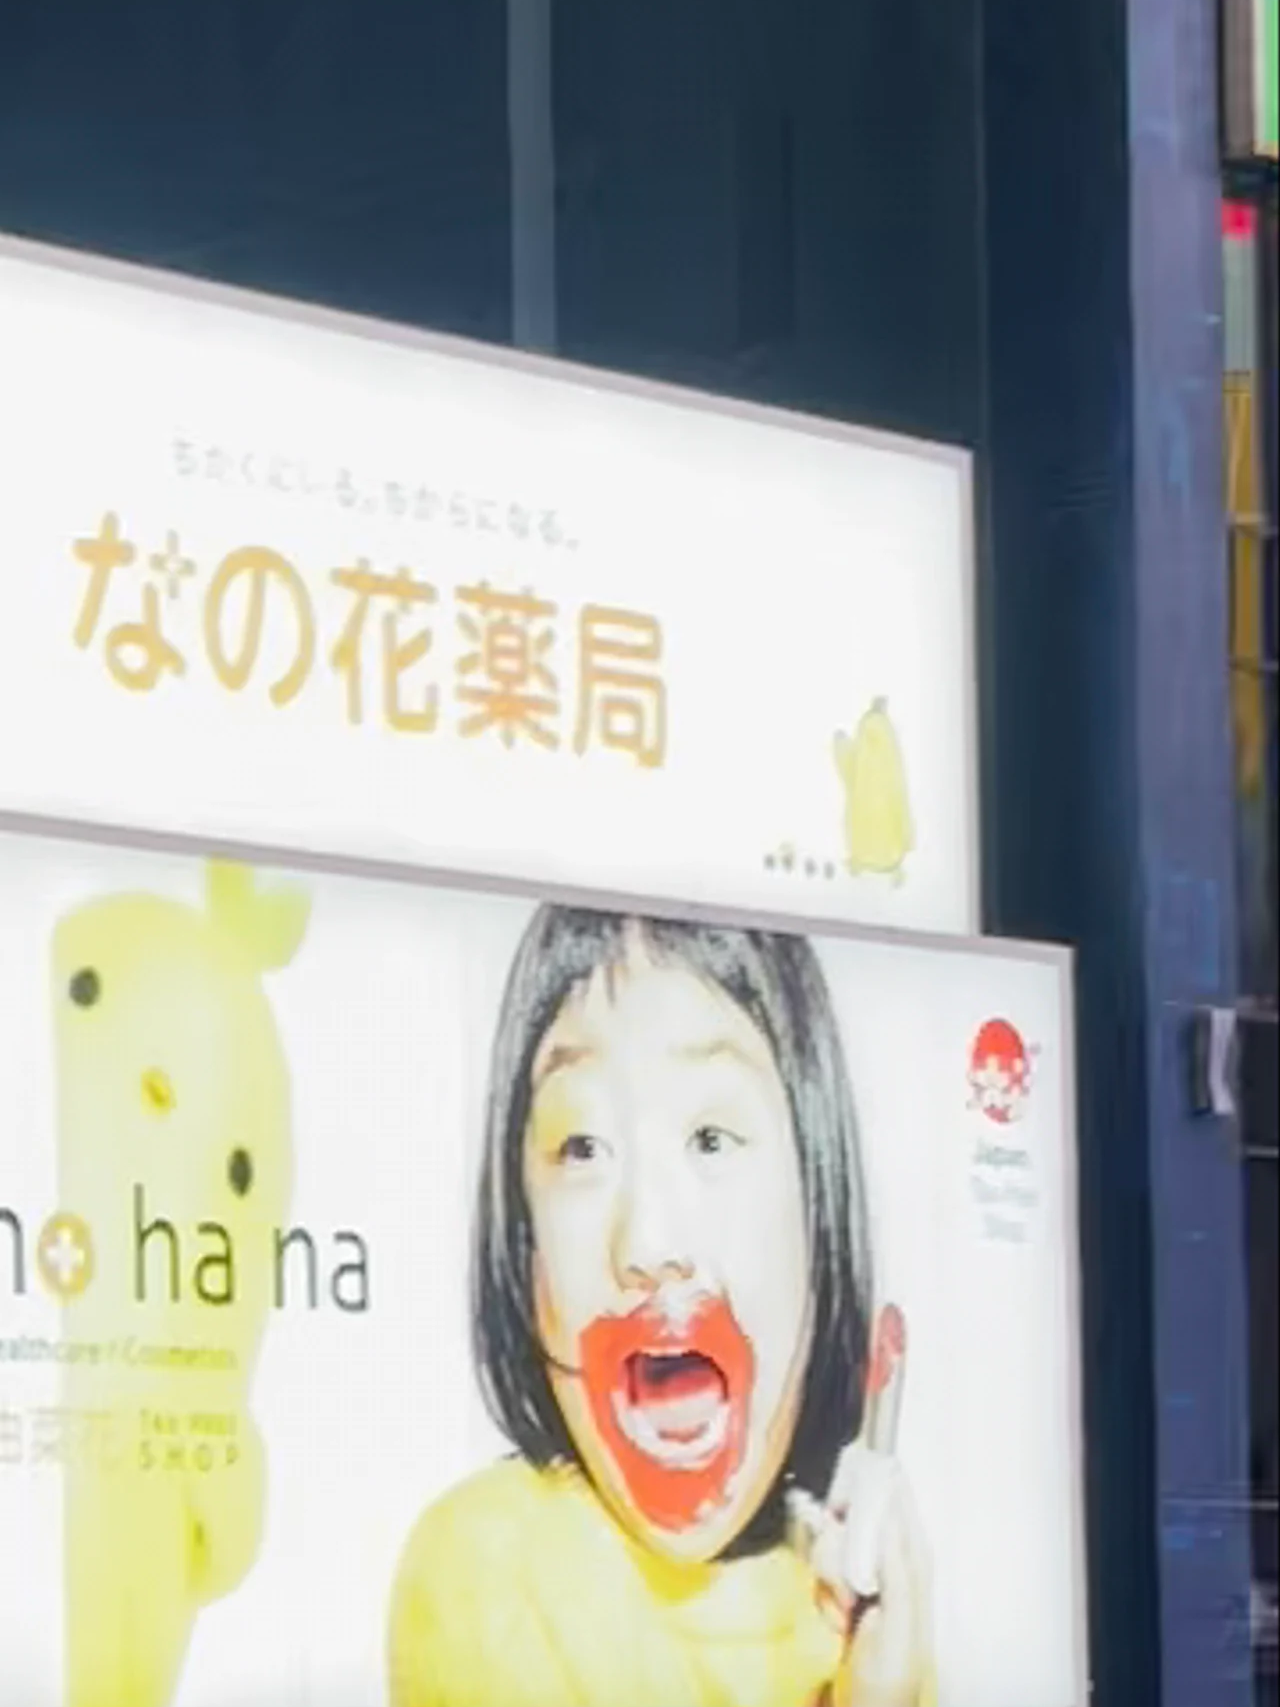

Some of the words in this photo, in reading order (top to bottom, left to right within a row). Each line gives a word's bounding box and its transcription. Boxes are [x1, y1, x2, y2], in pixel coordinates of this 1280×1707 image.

[72, 510, 670, 770] なの花薬局
